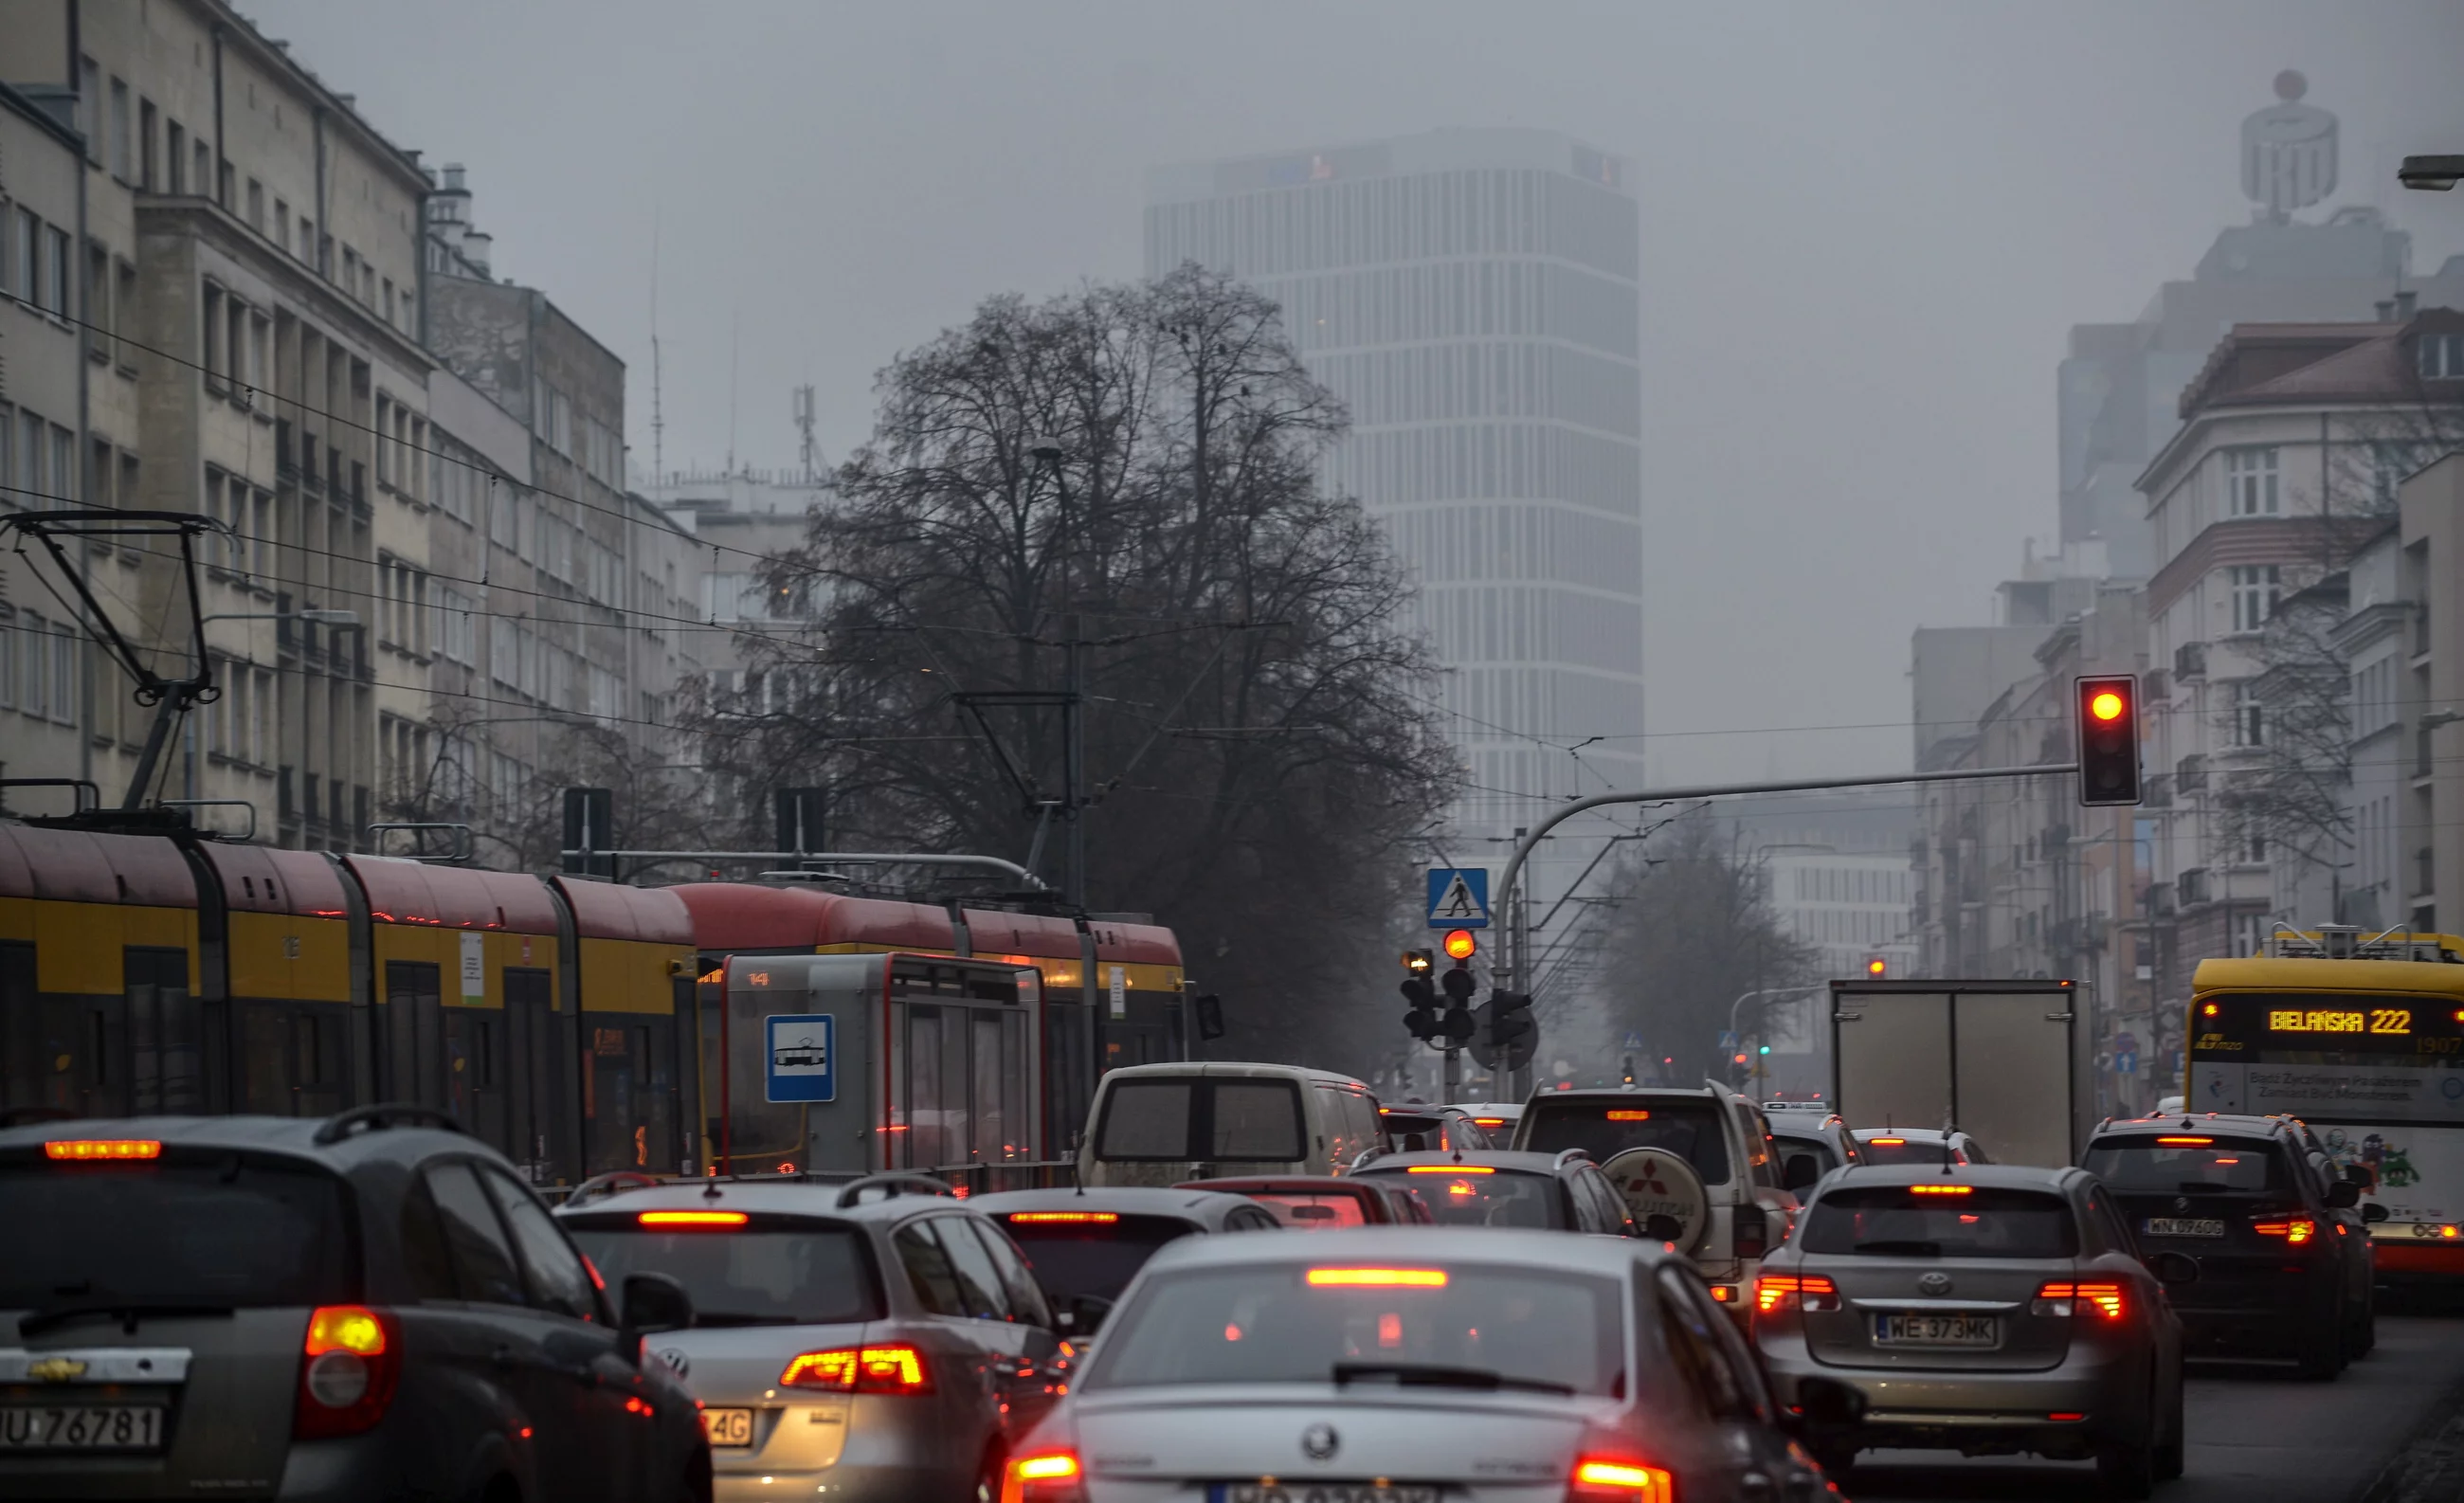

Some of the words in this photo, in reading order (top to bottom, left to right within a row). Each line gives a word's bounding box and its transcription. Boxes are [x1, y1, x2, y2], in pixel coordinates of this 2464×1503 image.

[2270, 1009, 2364, 1032] BIELAŃSKA
[2370, 1008, 2411, 1034] 222
[2416, 1037, 2463, 1054] 1907
[1891, 1318, 1921, 1337] WE
[1929, 1318, 1991, 1340] 373MK
[0, 1410, 31, 1442] U
[45, 1409, 153, 1443] 76781
